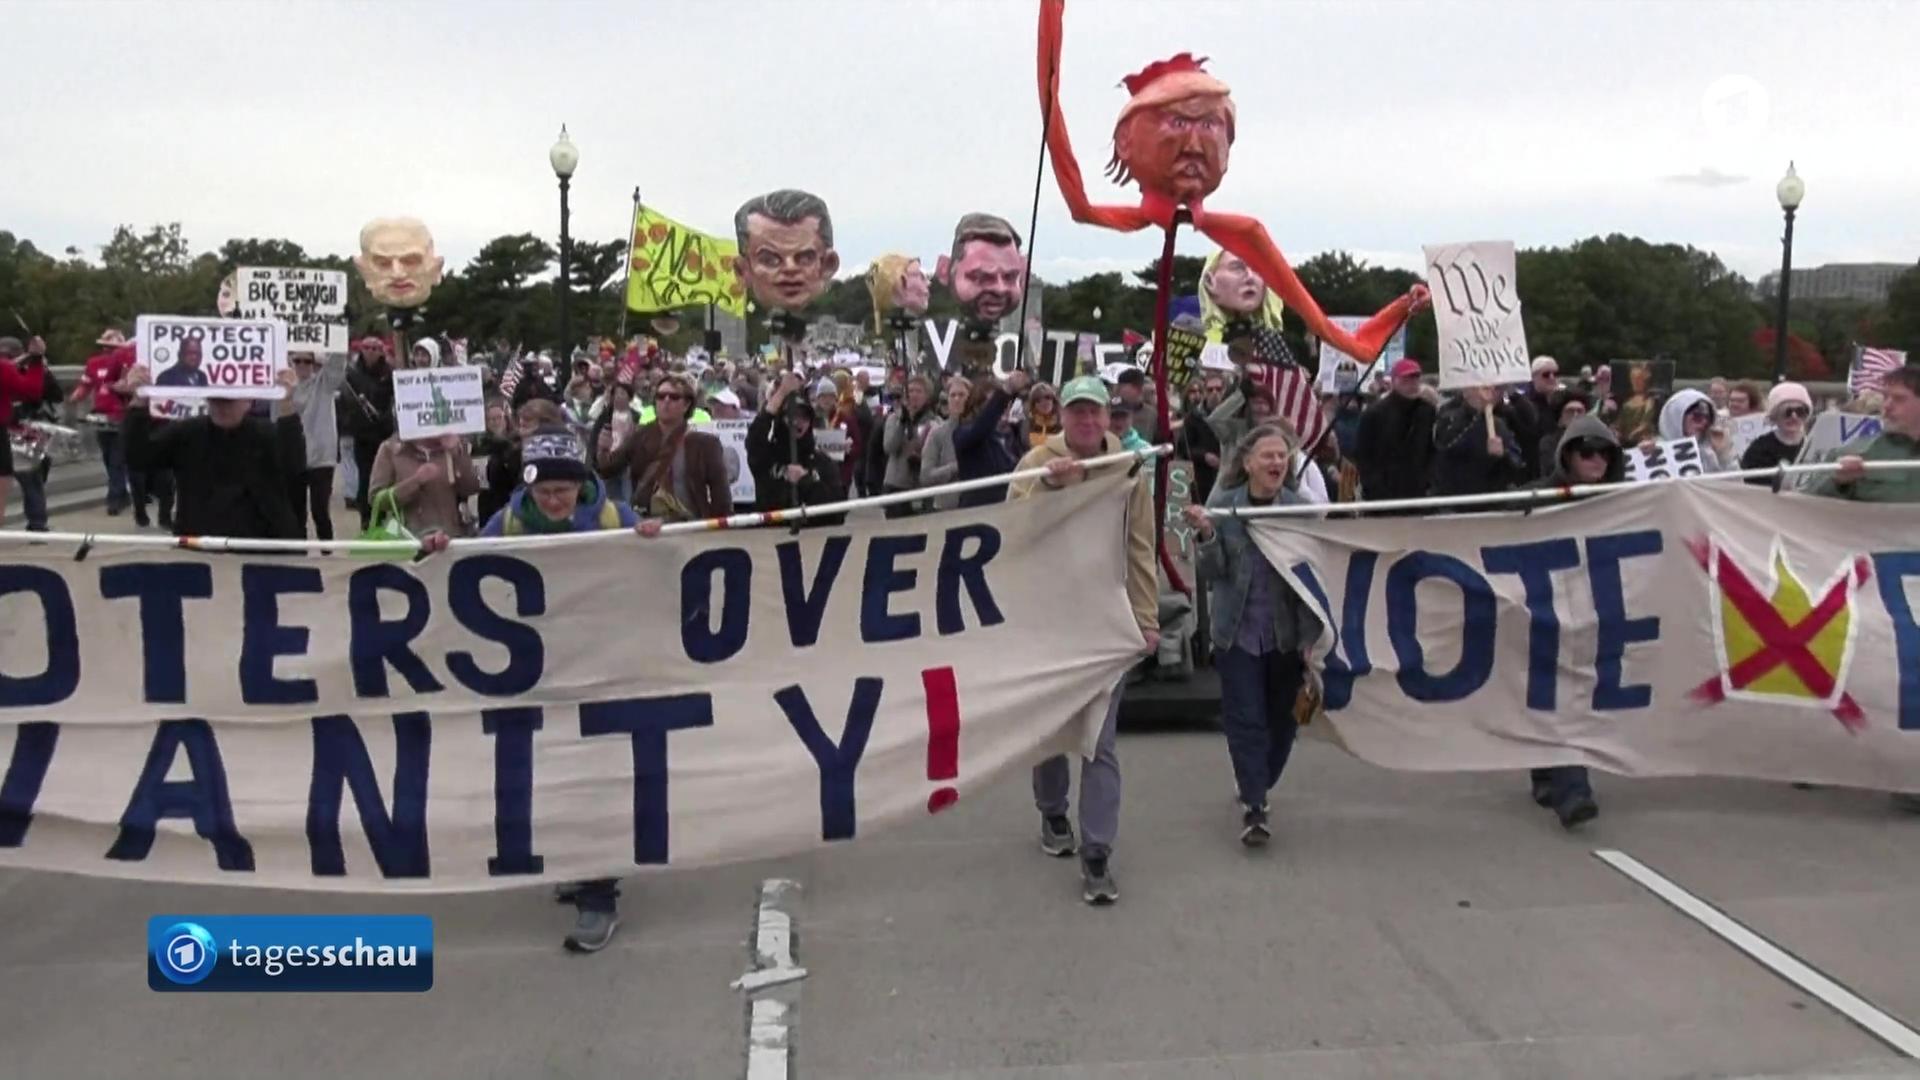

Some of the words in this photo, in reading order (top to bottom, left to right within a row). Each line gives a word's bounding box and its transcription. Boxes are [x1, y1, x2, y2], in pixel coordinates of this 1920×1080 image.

[649, 226, 703, 285] NO
[253, 270, 271, 281] NO
[278, 269, 306, 281] SIGN
[1431, 251, 1515, 317] We
[248, 282, 279, 305] BIG
[285, 283, 338, 305] ENOUGH
[273, 302, 287, 312] TO
[153, 325, 270, 343] PROTECT
[288, 323, 331, 348] HERE!
[212, 345, 265, 361] OUR
[1448, 336, 1526, 375] People
[207, 363, 271, 385] VOTE!
[681, 523, 1005, 663] OVER
[1291, 530, 1664, 711] VOTE
